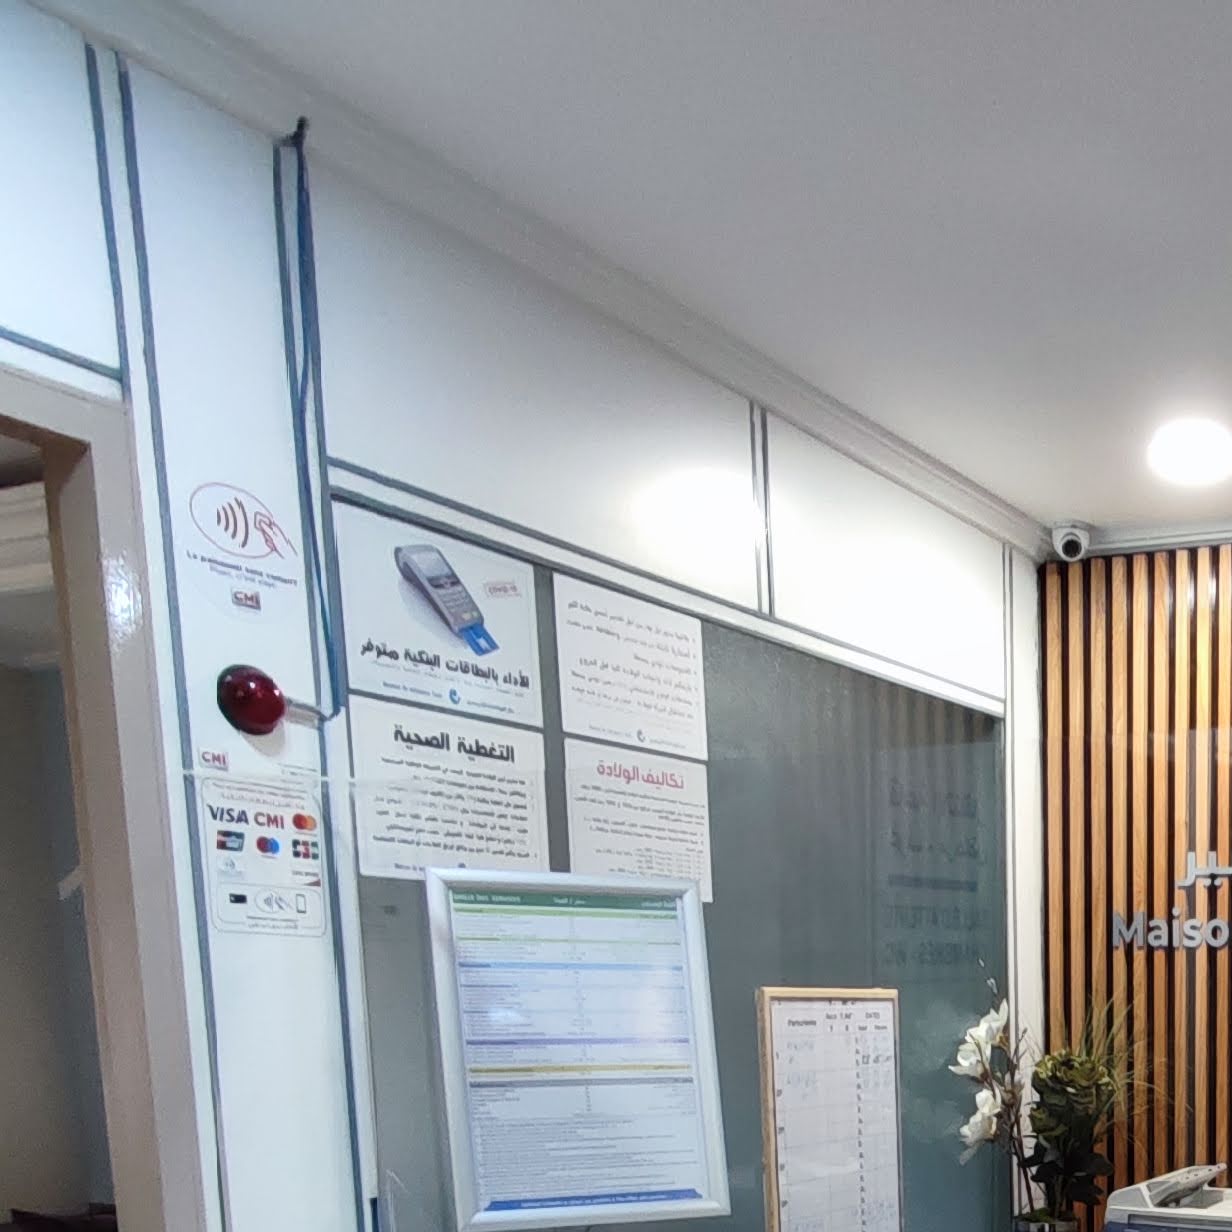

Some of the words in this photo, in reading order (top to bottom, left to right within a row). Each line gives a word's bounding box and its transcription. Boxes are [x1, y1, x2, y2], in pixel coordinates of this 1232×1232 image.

[393, 723, 450, 751] الصحية
[457, 736, 515, 763] التغطية
[201, 751, 228, 765] CMI
[596, 760, 640, 785] الولادة
[642, 768, 684, 790] تكاليف
[207, 804, 249, 825] VISA
[253, 812, 285, 830] CMI
